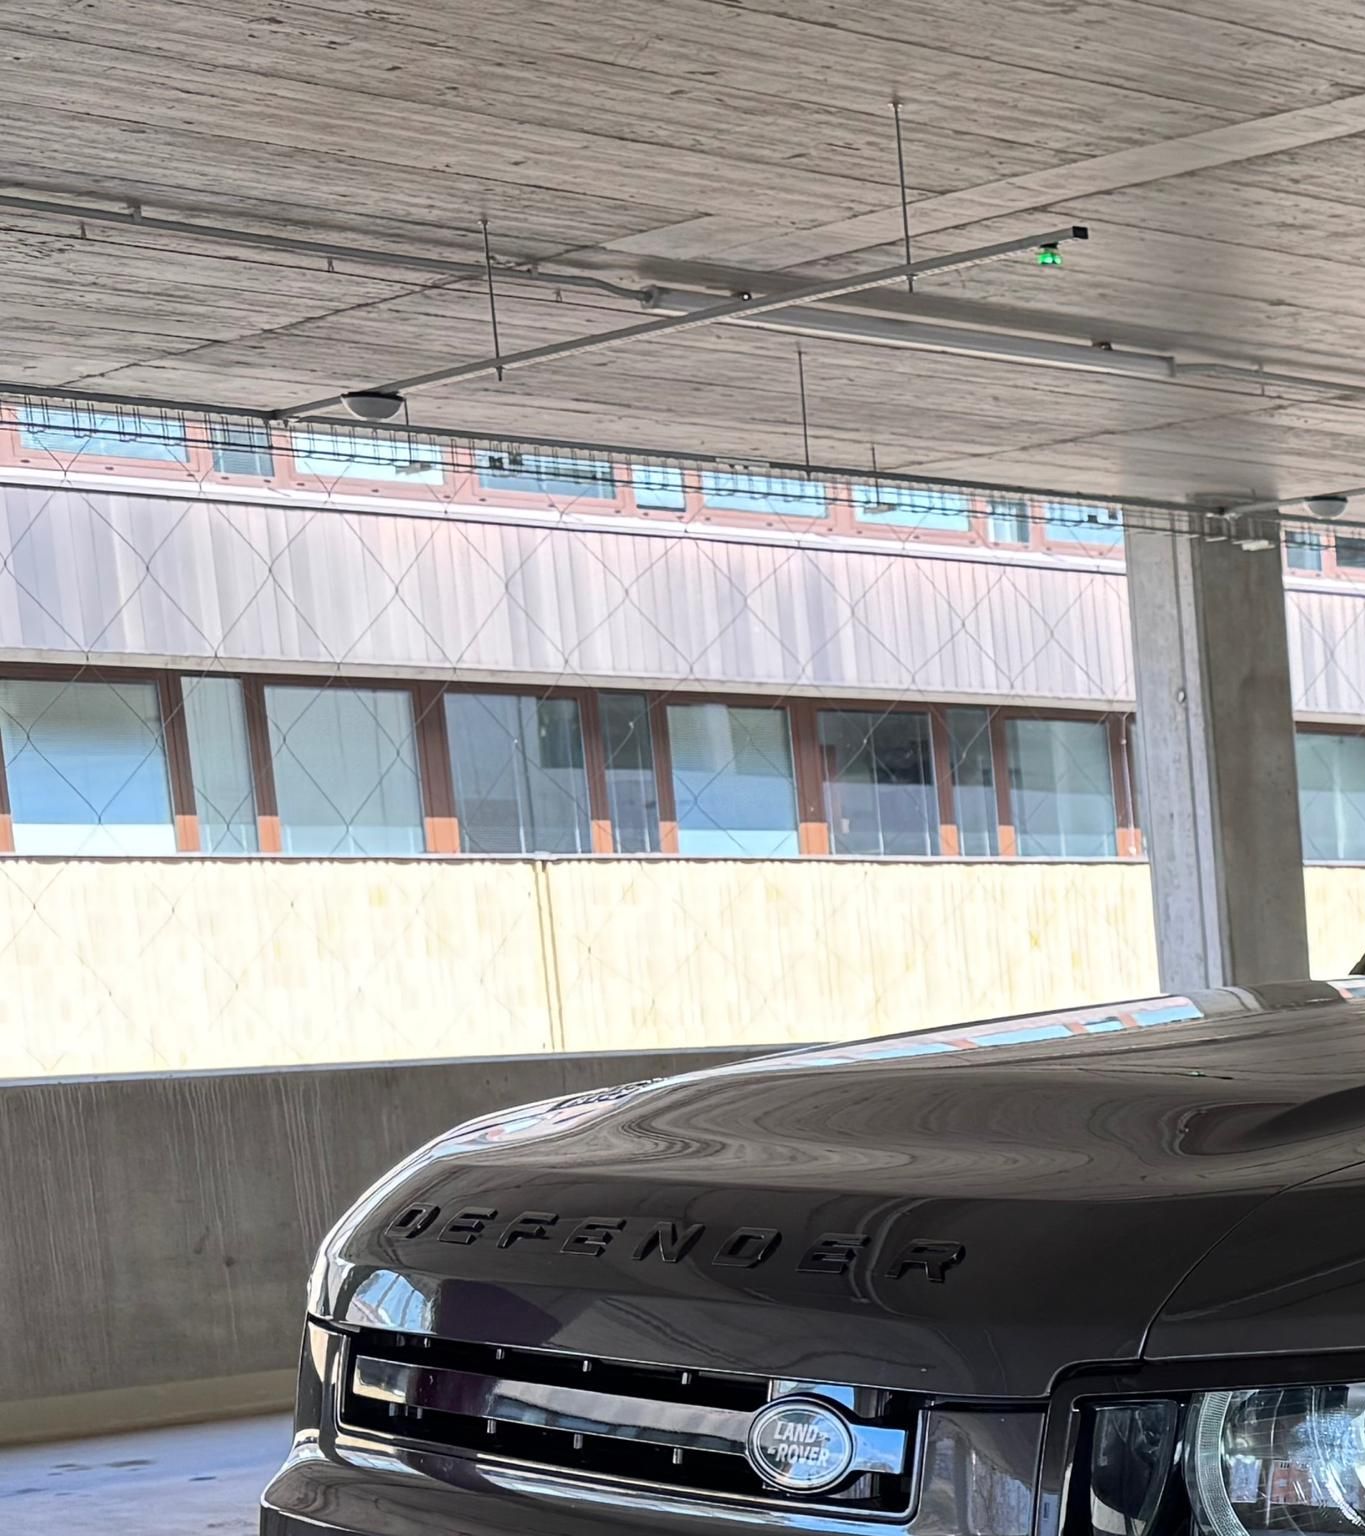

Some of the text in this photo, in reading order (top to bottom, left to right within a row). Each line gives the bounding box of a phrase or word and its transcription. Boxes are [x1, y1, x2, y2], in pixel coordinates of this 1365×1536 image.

[385, 1201, 966, 1284] DEFENDER
[774, 1421, 819, 1443] LAND
[775, 1443, 830, 1467] ROVER
